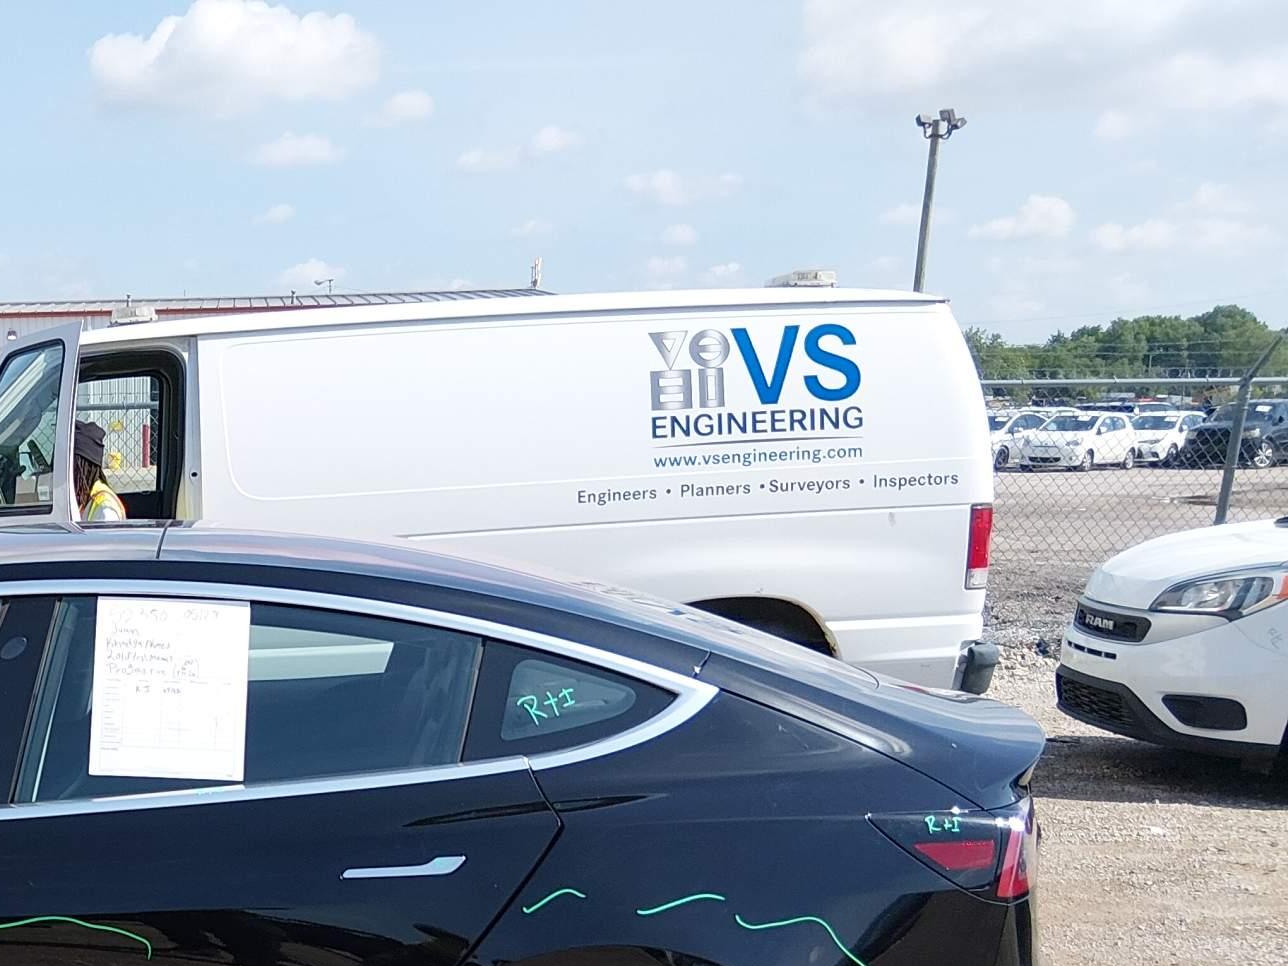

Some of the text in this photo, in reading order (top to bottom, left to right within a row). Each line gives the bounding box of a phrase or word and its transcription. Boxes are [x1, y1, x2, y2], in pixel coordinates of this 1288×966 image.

[730, 323, 862, 405] VS
[651, 405, 864, 439] ENGINEERING
[653, 445, 863, 468] www.vsengineering.com
[577, 472, 960, 504] Engineers Planners Surveyors Inspectors
[1086, 615, 1114, 630] RAM
